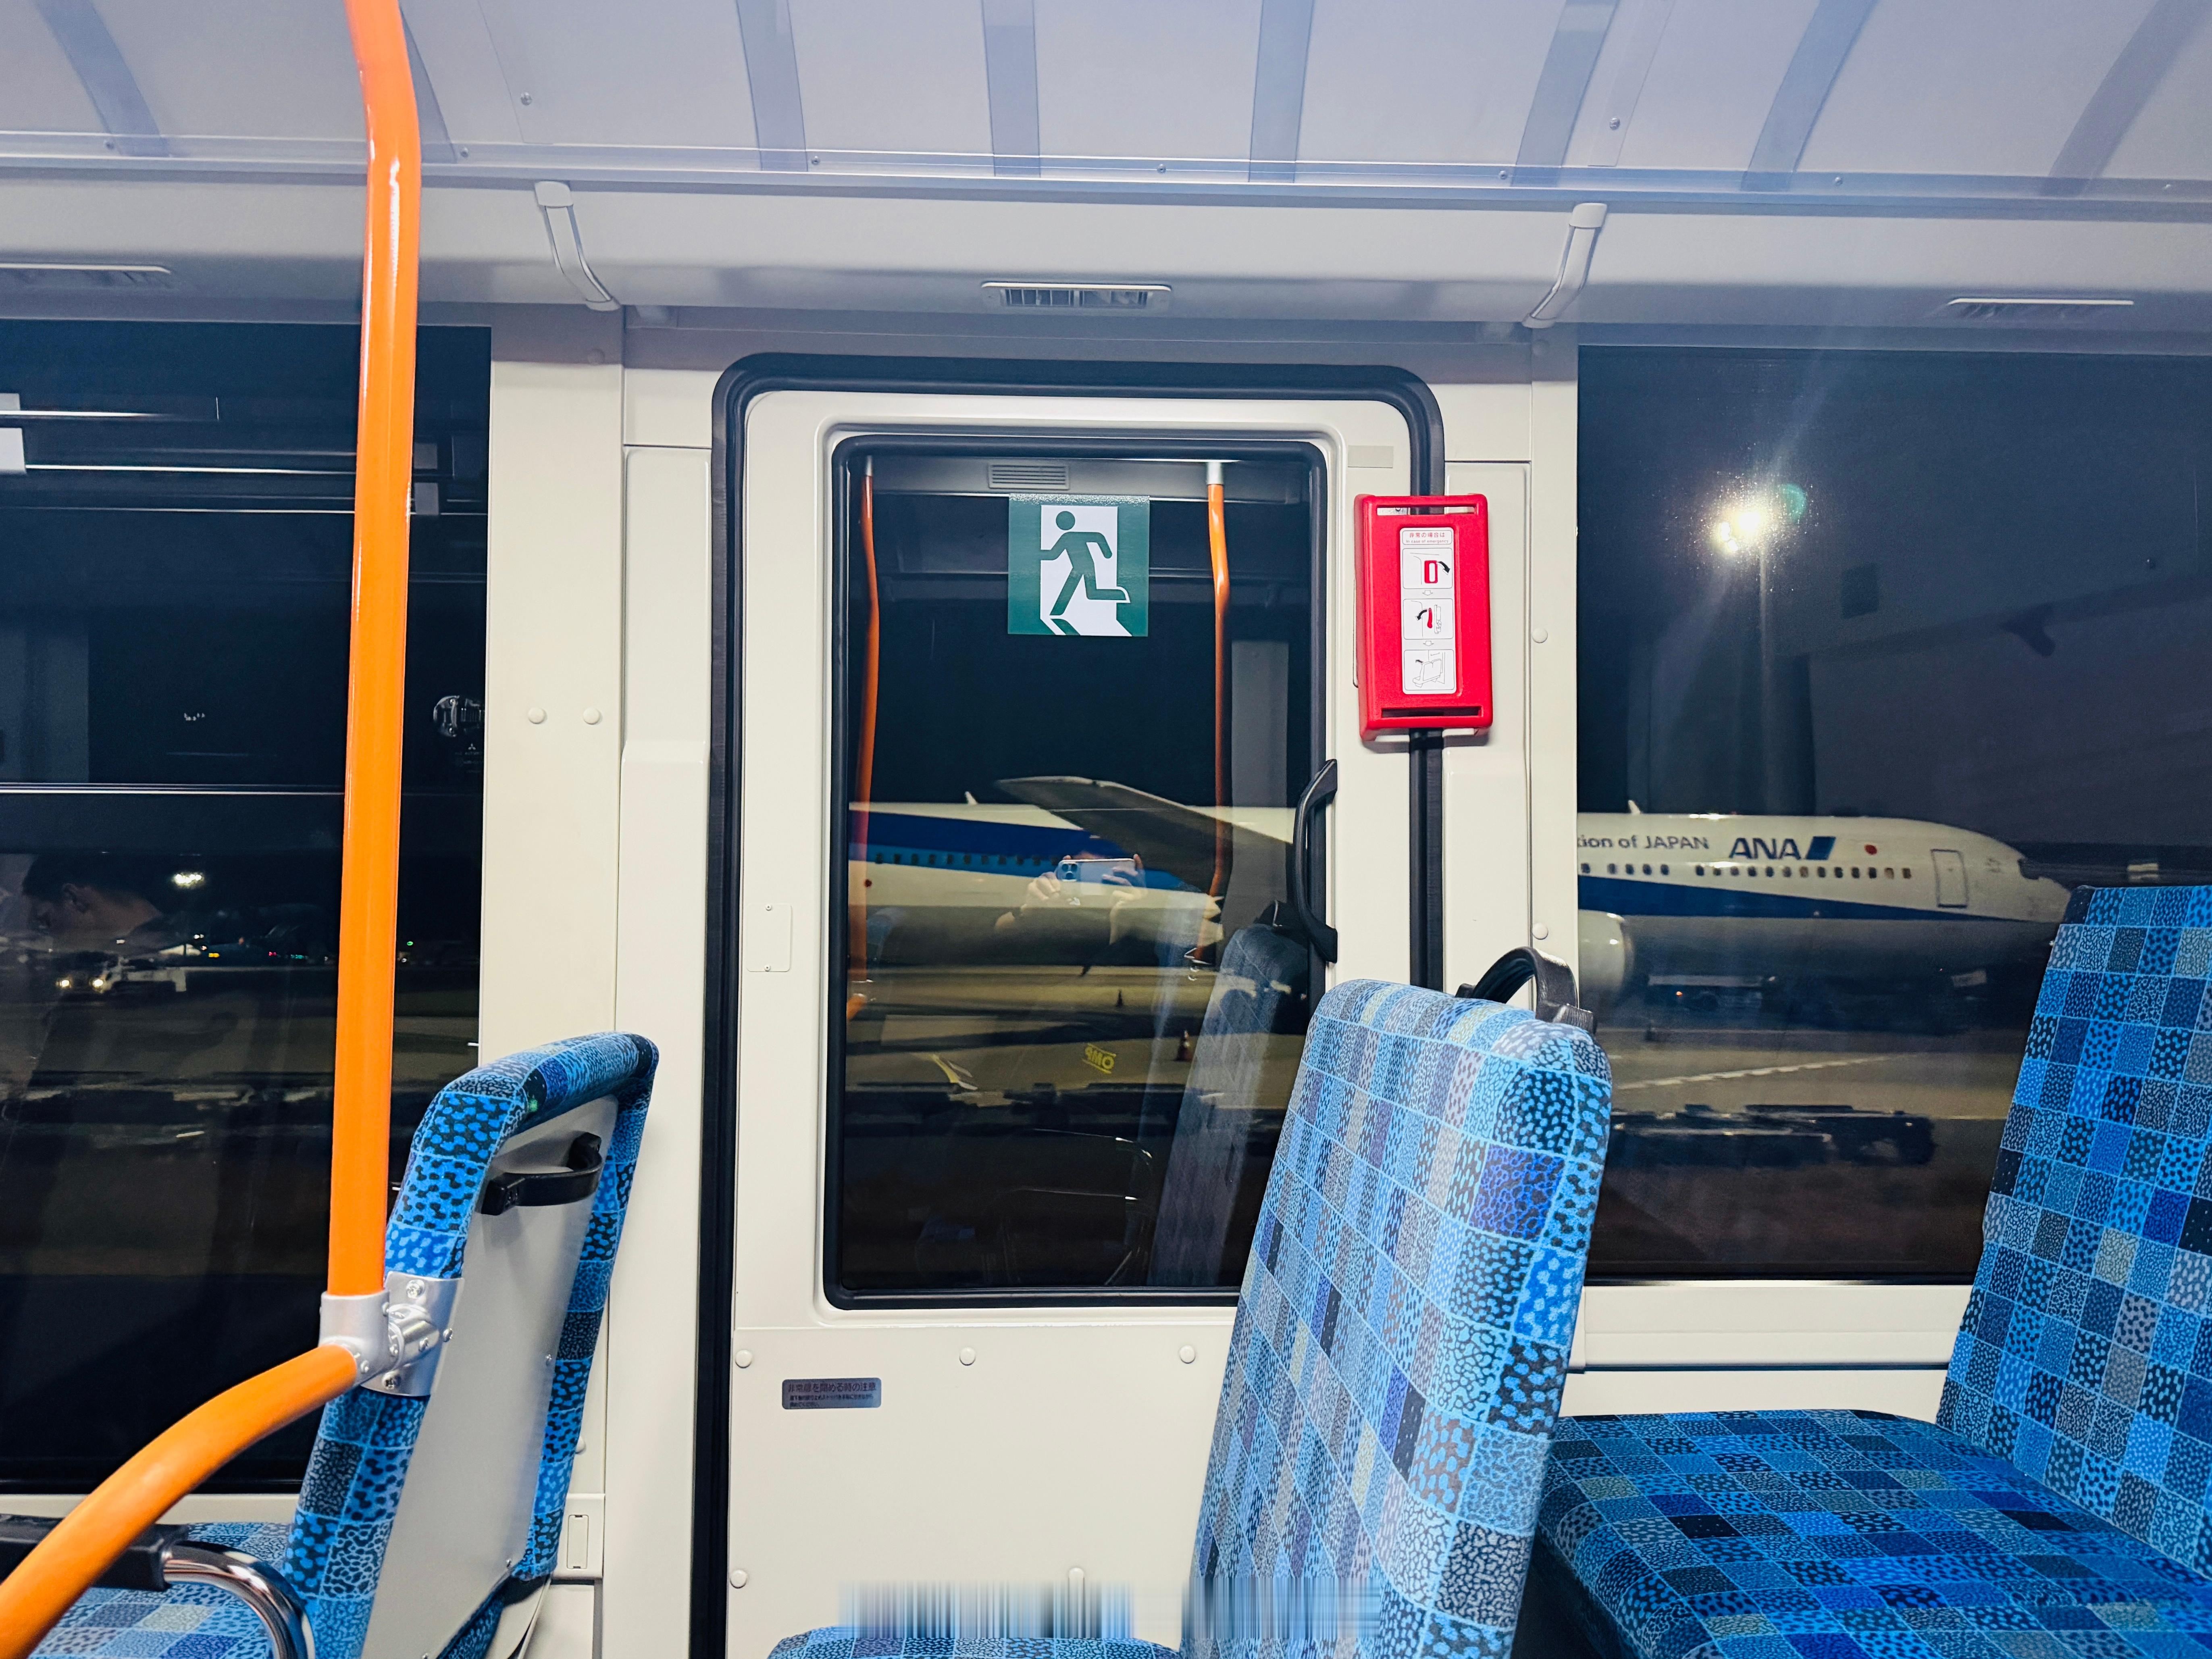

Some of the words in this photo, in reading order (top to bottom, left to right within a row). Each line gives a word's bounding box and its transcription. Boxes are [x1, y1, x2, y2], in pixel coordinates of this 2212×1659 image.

[1617, 835, 1638, 848] of
[1645, 836, 1709, 849] JAPAN
[1729, 837, 1802, 860] ANA
